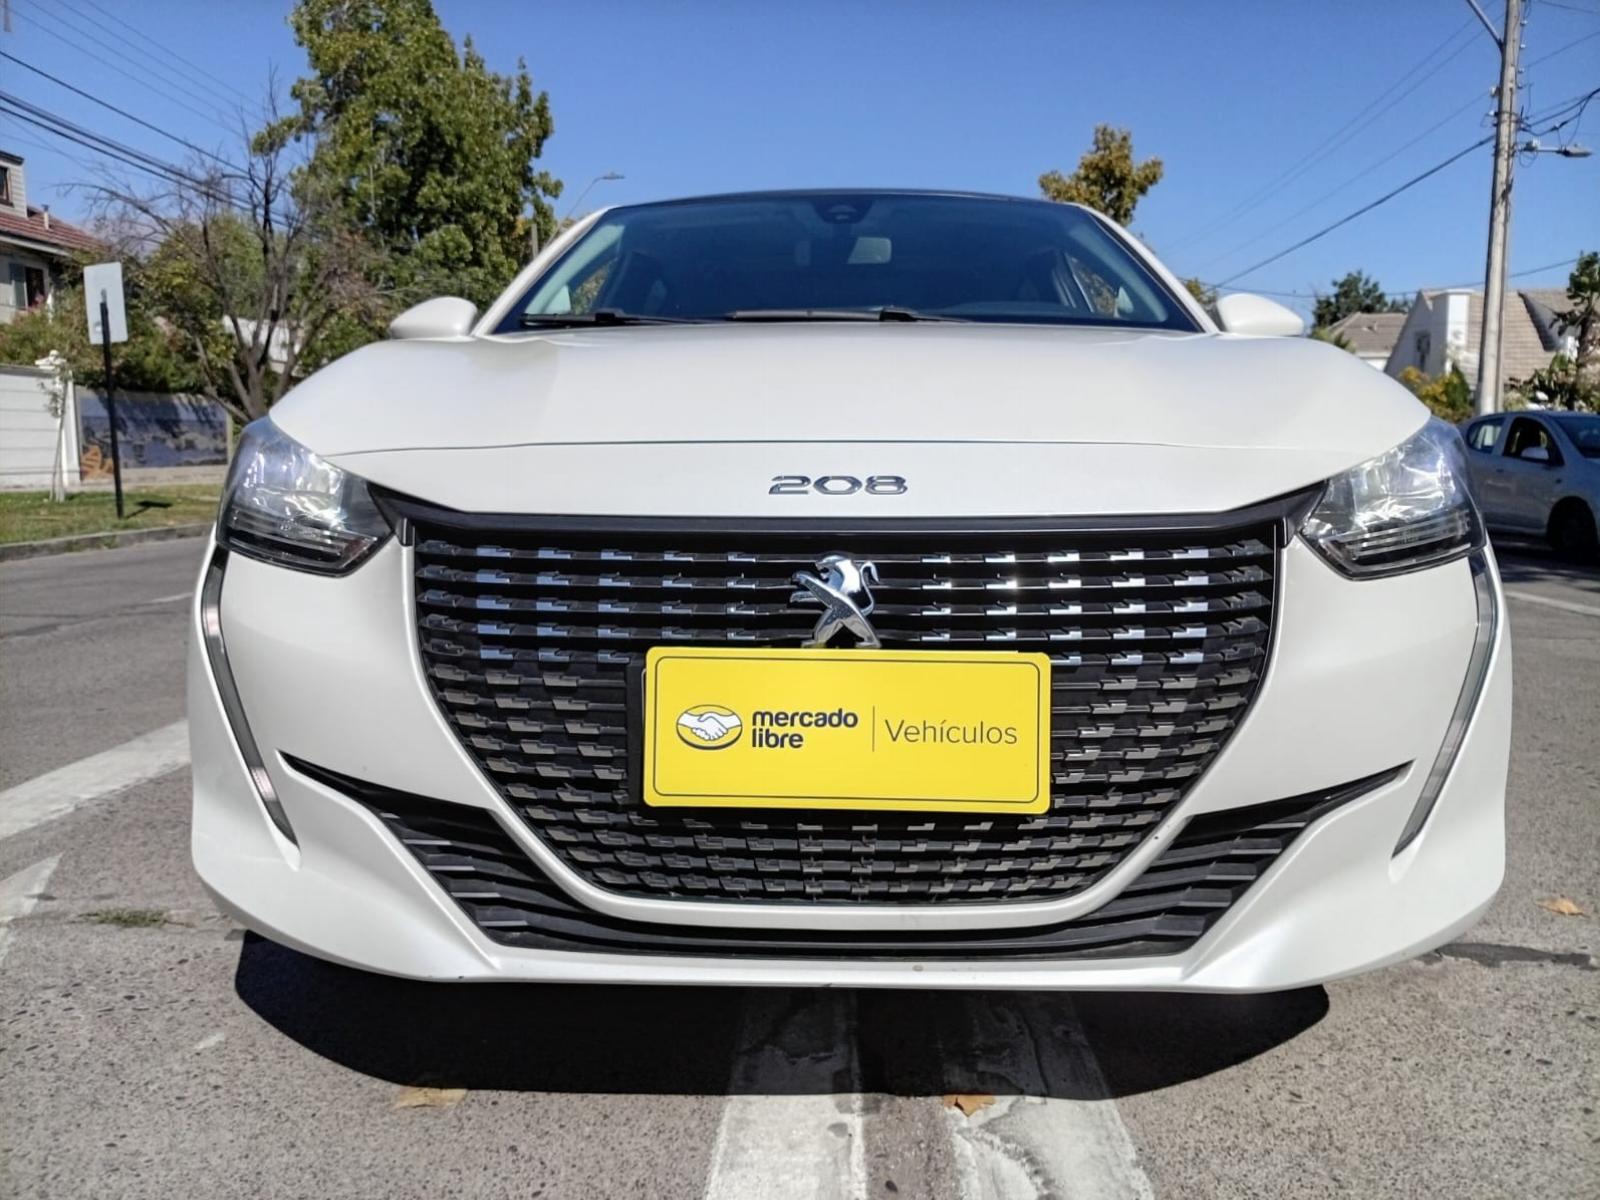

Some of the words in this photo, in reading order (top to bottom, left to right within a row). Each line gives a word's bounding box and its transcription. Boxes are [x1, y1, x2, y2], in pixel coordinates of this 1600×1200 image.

[768, 475, 908, 495] 208
[752, 708, 859, 728] mercado
[752, 727, 804, 749] libre
[884, 719, 1018, 745] Vehículos
